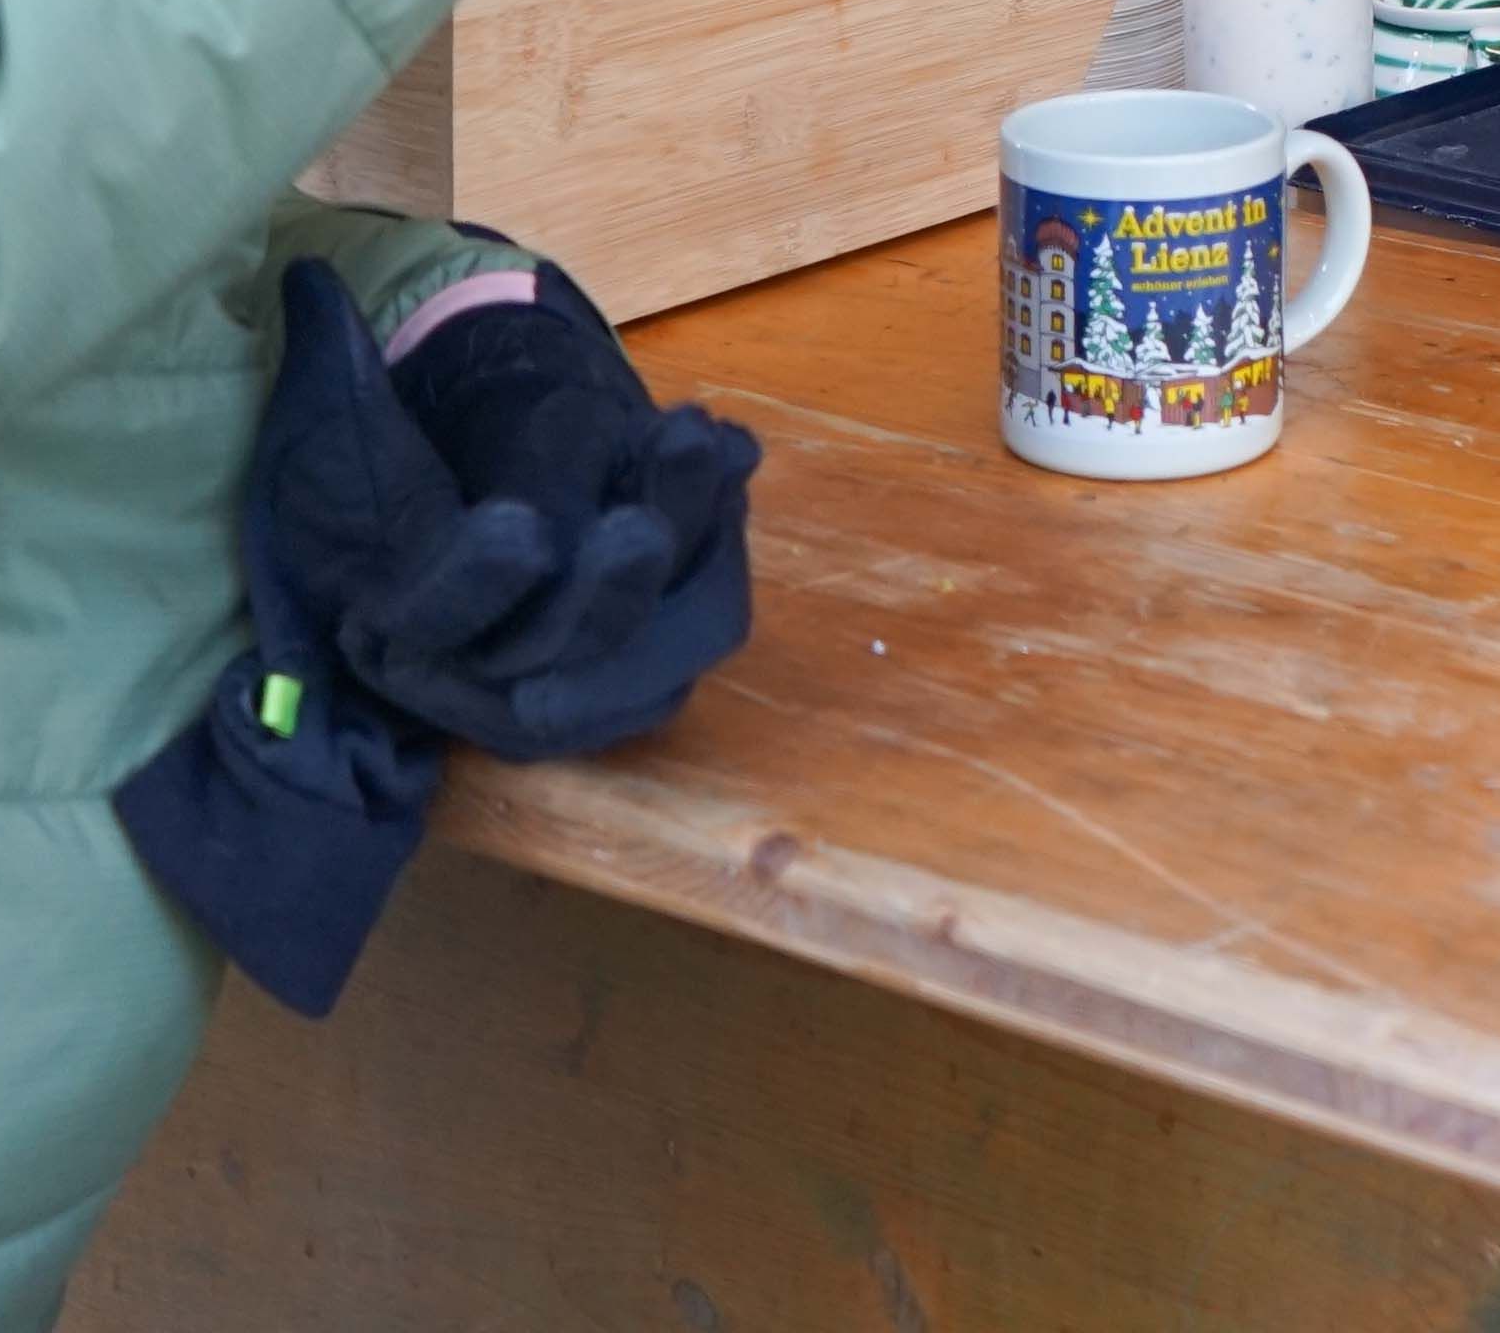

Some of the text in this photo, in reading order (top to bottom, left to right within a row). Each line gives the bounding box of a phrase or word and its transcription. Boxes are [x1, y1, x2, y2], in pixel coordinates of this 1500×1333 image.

[1113, 194, 1267, 239] Advent in
[1130, 241, 1229, 274] Lienz
